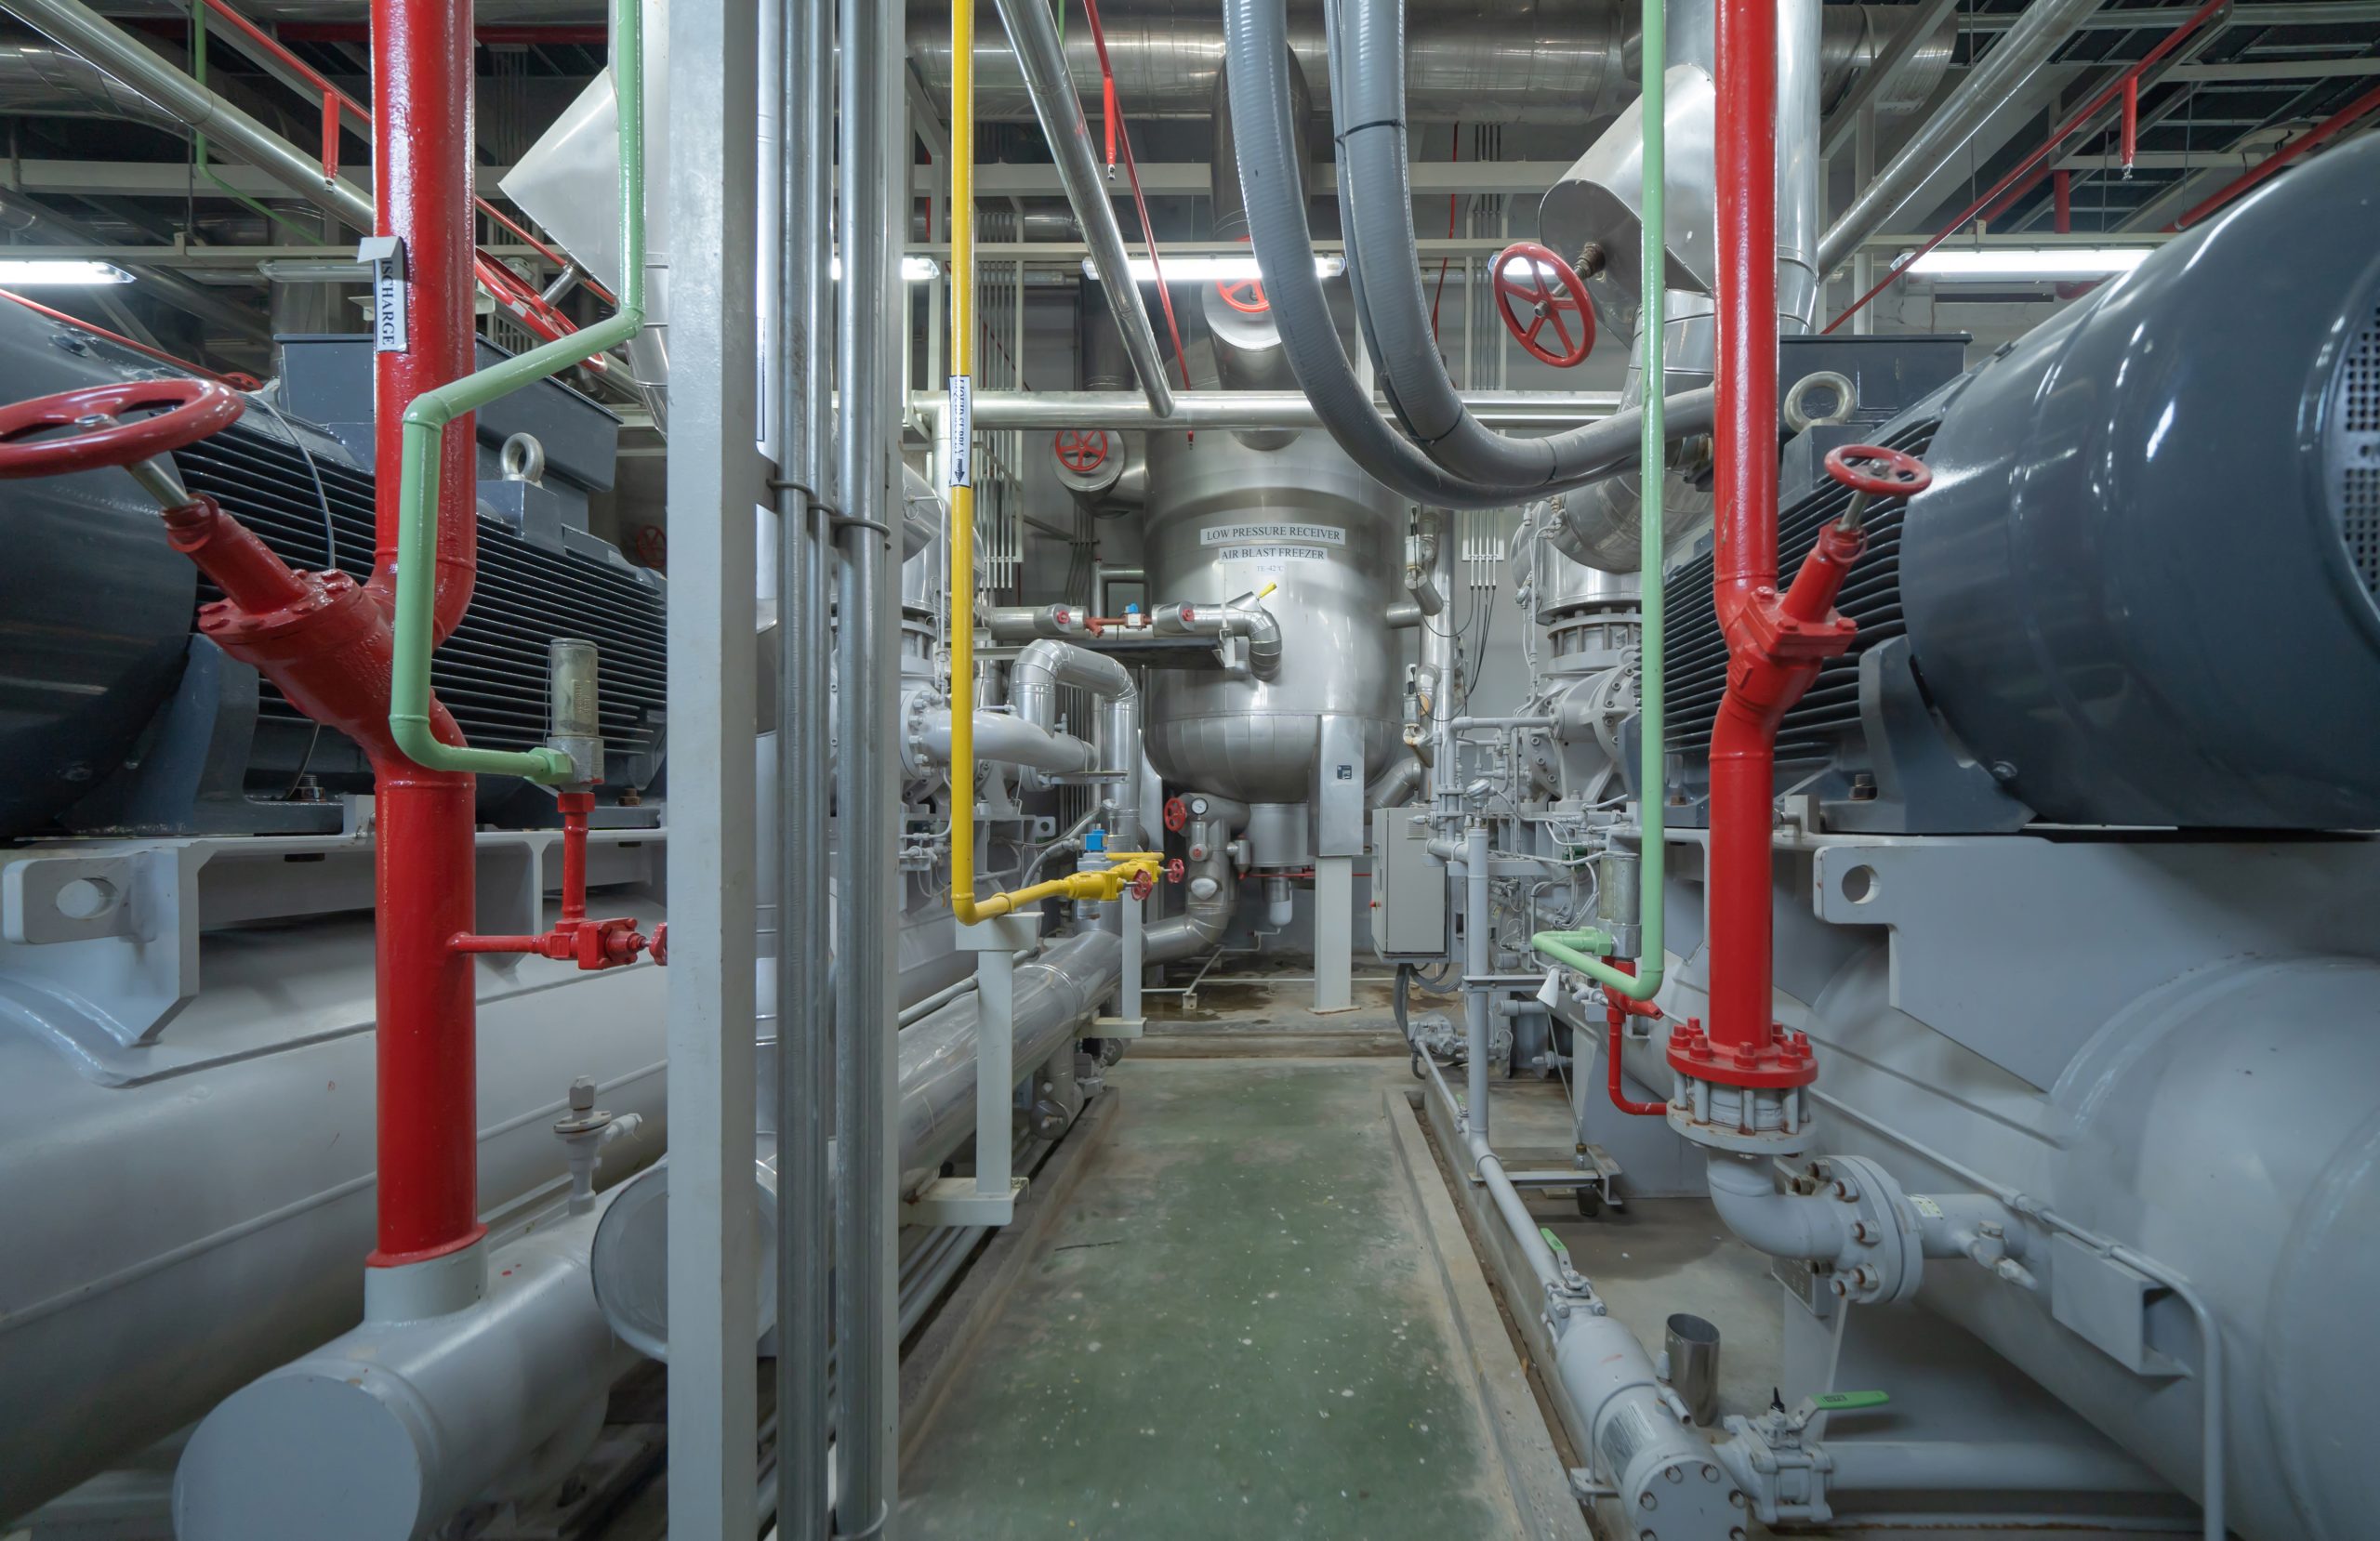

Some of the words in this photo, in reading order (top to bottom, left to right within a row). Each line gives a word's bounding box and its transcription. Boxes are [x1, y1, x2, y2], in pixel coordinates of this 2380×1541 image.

[381, 258, 395, 346] ISCHARGE
[1207, 530, 1230, 541] LOW
[1233, 526, 1287, 537] PRESSURE
[1289, 527, 1340, 541] RECEIVER
[1221, 549, 1238, 560] AIR
[1241, 547, 1276, 558] BLAST
[1278, 547, 1325, 560] FREEZER
